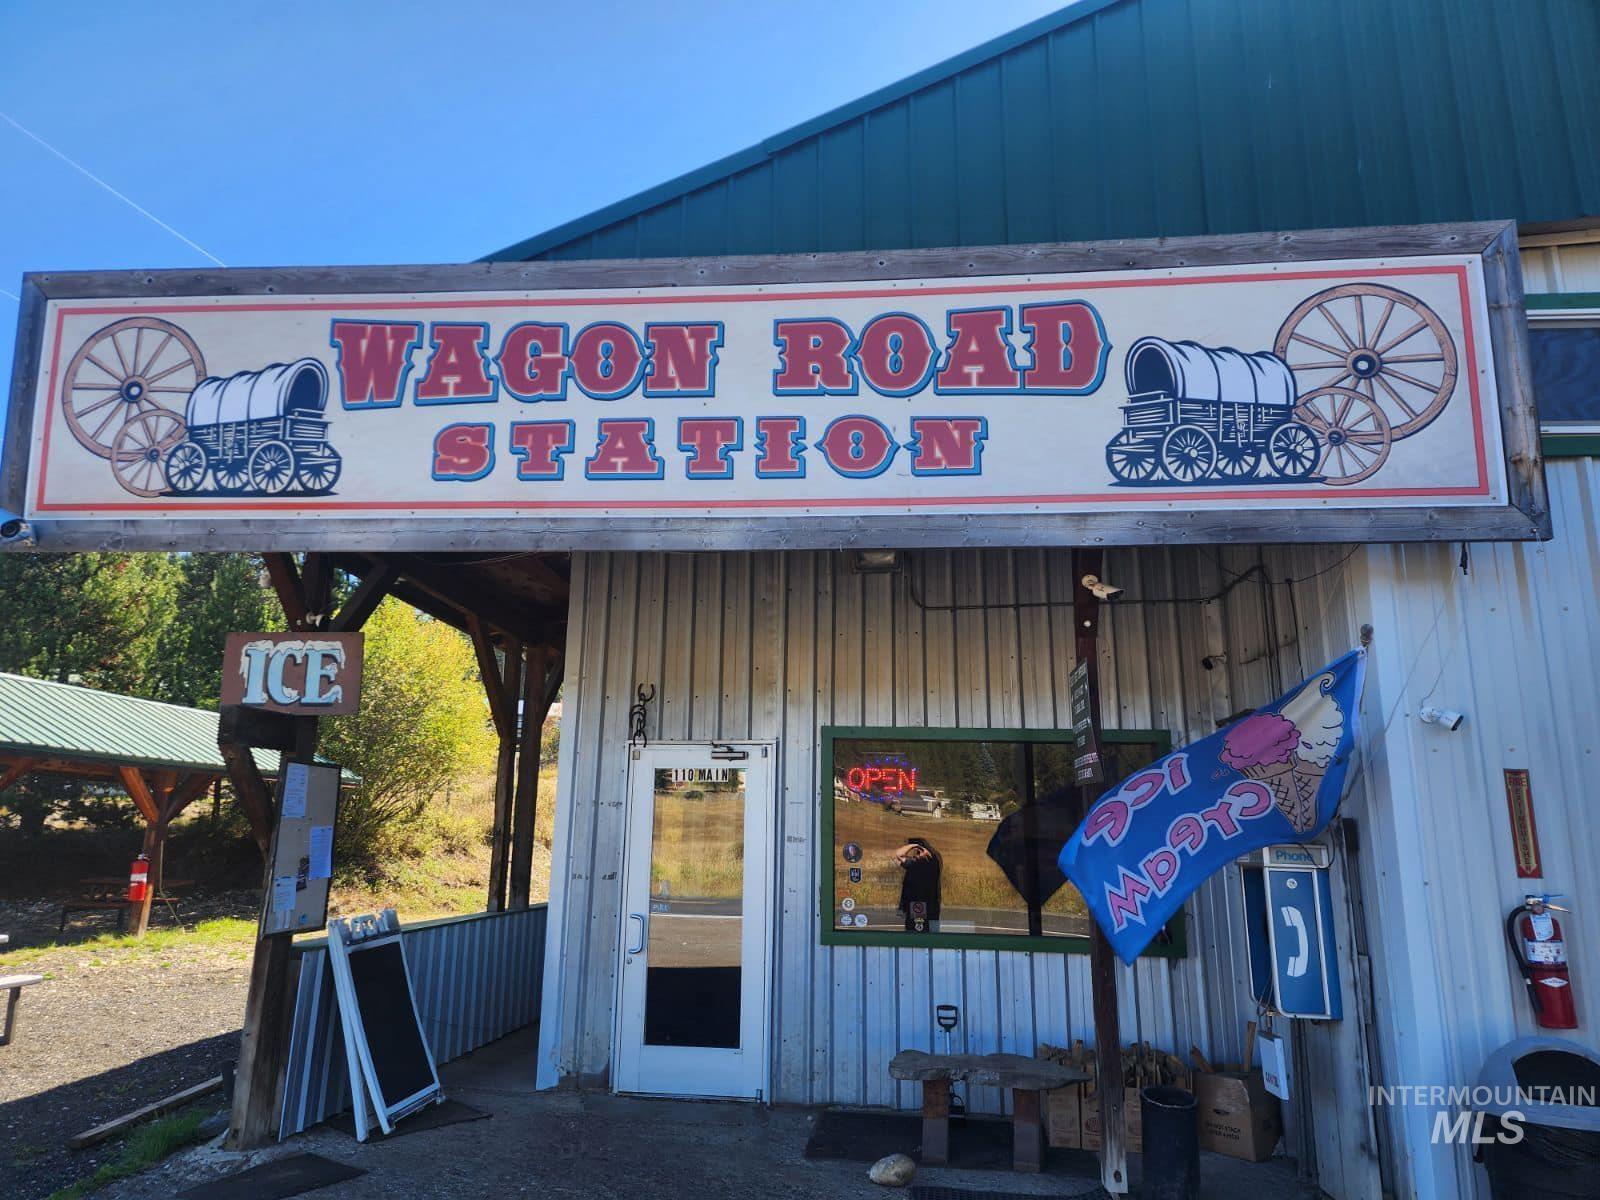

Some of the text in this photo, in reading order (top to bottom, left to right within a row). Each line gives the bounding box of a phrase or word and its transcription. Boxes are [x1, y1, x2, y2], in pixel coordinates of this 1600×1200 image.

[329, 300, 1112, 410] WAGON ROAD
[432, 415, 989, 482] STATION
[239, 640, 346, 707] ICE
[674, 768, 728, 781] 110 MAIN
[847, 767, 919, 793] OPEN
[1275, 850, 1313, 862] Phone
